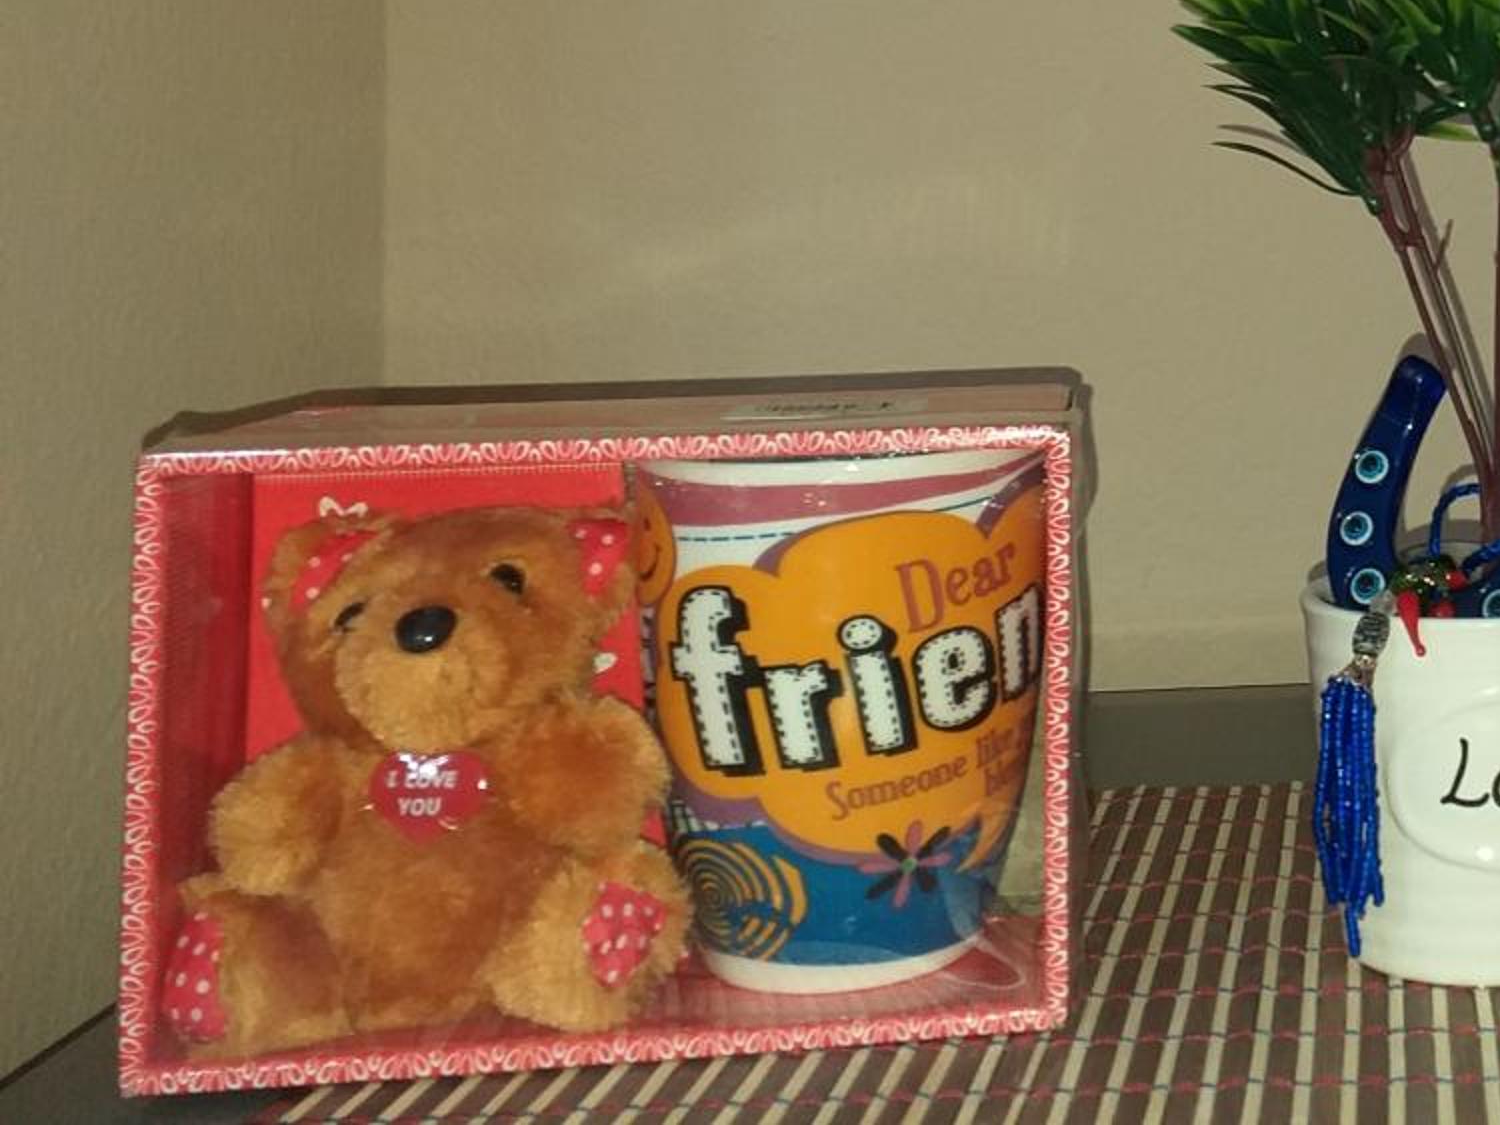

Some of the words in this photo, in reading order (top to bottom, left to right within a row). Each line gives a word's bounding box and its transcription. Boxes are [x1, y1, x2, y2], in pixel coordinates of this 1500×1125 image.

[894, 543, 1015, 633] Dear
[385, 770, 399, 788] I
[824, 755, 968, 821] Someone
[397, 796, 443, 816] YOU
